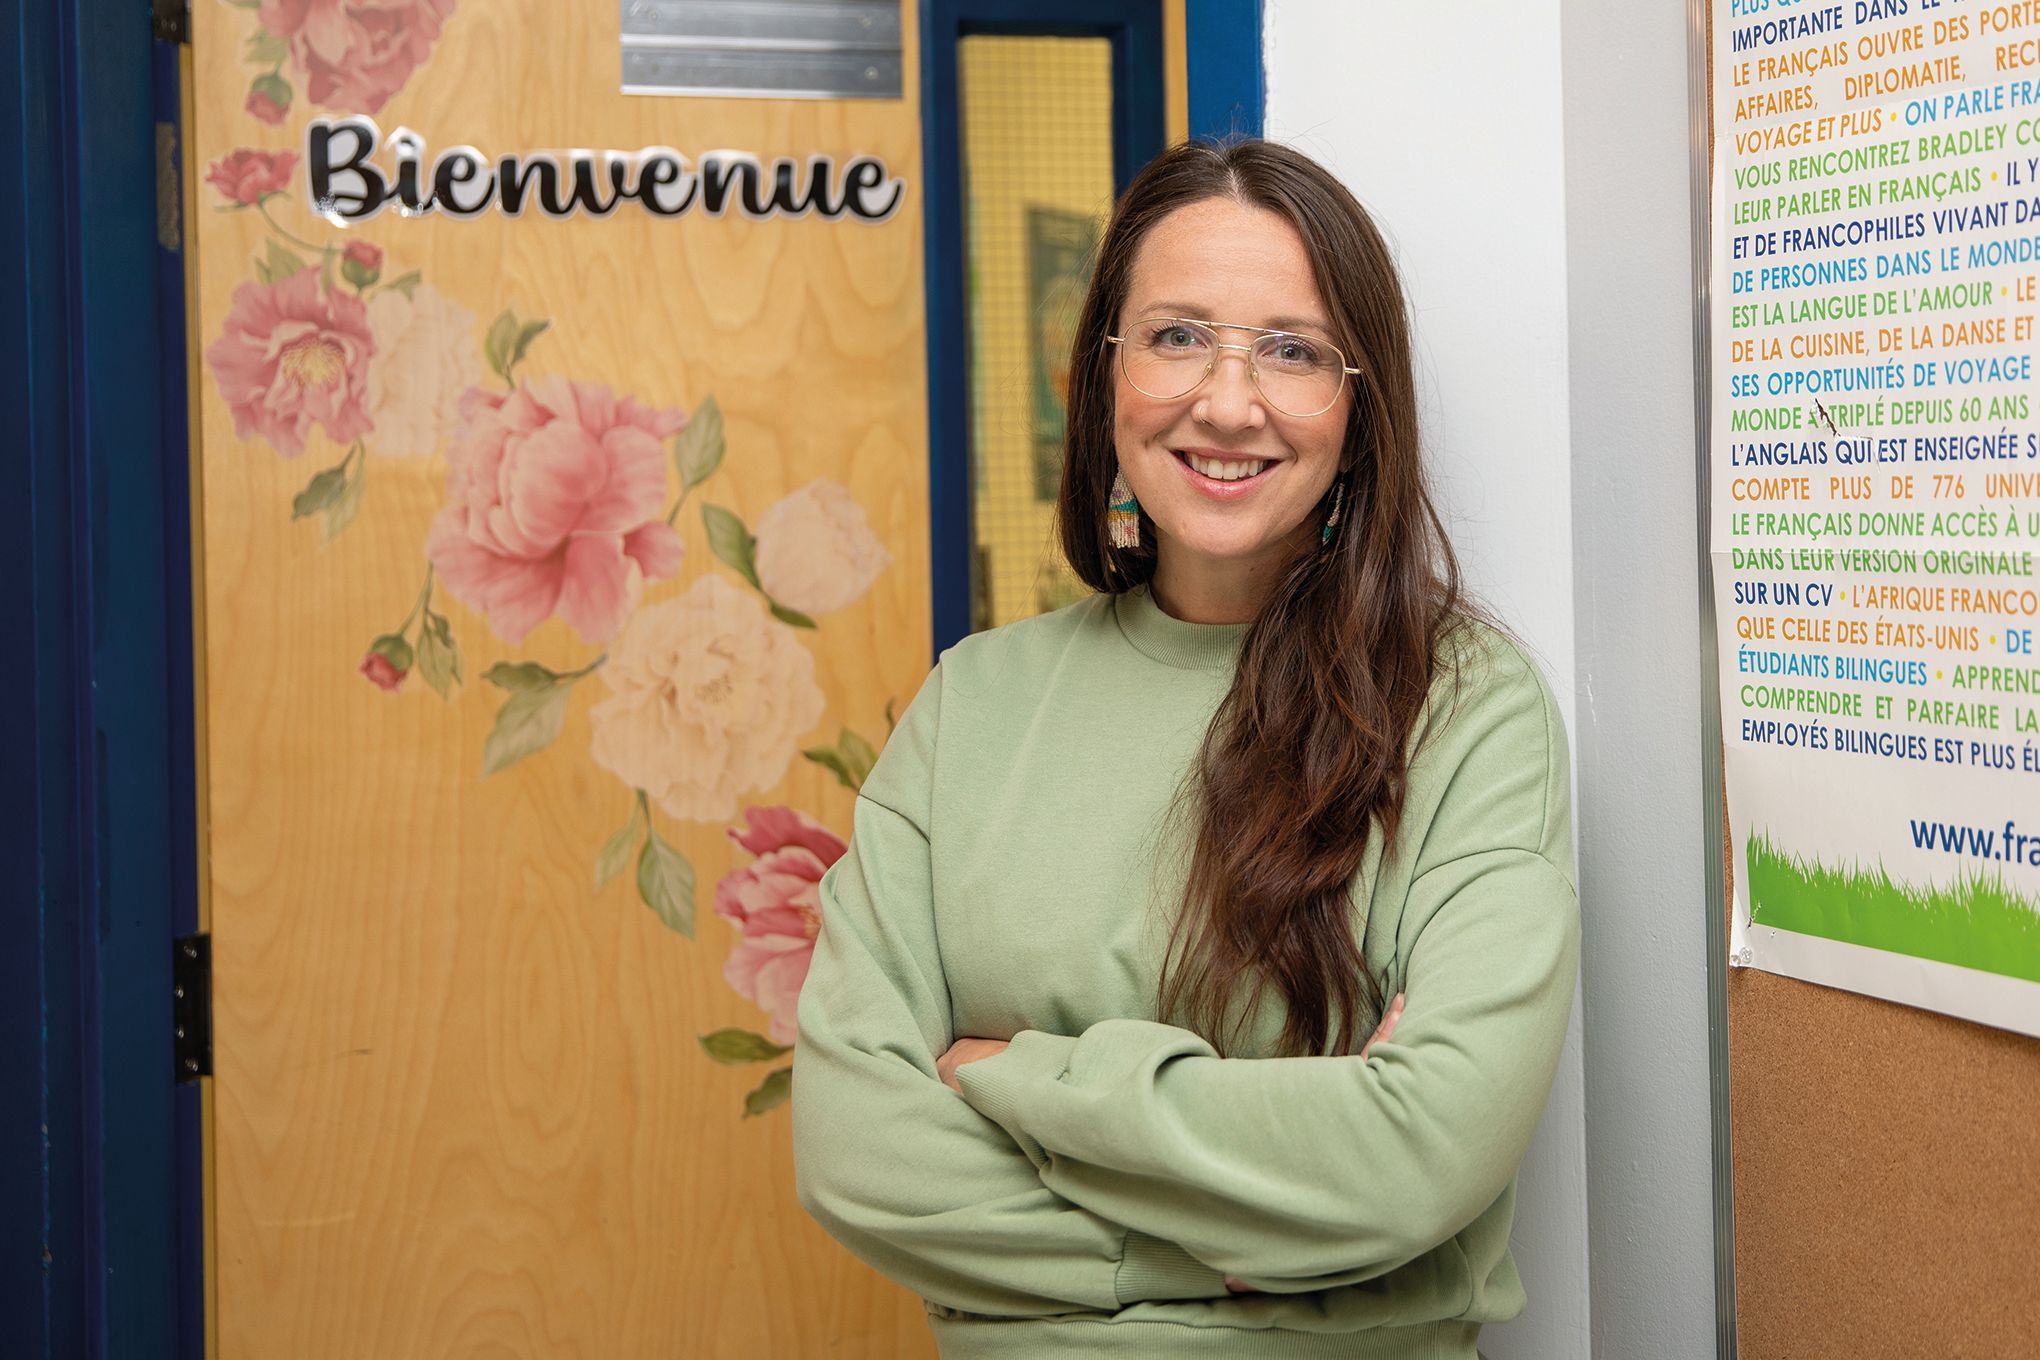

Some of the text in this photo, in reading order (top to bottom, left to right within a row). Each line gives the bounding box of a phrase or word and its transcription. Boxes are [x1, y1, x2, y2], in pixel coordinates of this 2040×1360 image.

[1733, 0, 1908, 52] IMPORTANTE DANS
[1734, 0, 2040, 87] LE FRANÇAIS OUVRE DES PORTE
[1735, 39, 2040, 123] AFFAIRES, DIPLOMATIE, REC
[1736, 121, 1812, 156] VOYAGE
[1817, 116, 1836, 142] ET
[1840, 108, 1882, 137] PLUS
[1905, 98, 1936, 126] ON
[1944, 85, 2003, 119] PARLE
[307, 120, 901, 218] Bienvenue
[1735, 161, 1781, 190] VOUS
[1789, 140, 1910, 181] RENCONTREZ
[1919, 124, 2007, 161] BRADLEY
[1735, 157, 2038, 225] LEUR PARLER EN FRANÇAIS IL Y
[1734, 236, 1749, 259] ET
[1755, 232, 1776, 256] DE
[1783, 213, 1925, 253] FRANCOPHILES
[1933, 201, 2008, 234] VIVANT
[1733, 236, 2040, 294] DE PERSONNES DANS LE MONDE
[1733, 276, 2035, 328] EST LA LANGUE DE L'AMOUR LE
[1732, 316, 2033, 363] DE LA CUISINE, DE LA DANSE ET
[1731, 355, 2030, 398] SES OPPORTUNITÉS DE VOYAGE
[1732, 407, 1802, 432] MONDE
[1829, 395, 1884, 428] TRIPLÉ
[1892, 399, 1952, 425] DEPUIS
[1960, 397, 1981, 422] 60
[1988, 395, 2028, 420] ANS
[1732, 427, 2040, 466] L'ANGLAIS QUI EST ENSEIGNÉE S
[1732, 473, 2040, 501] COMPTE PLUS DE 776 UNIV
[1733, 513, 1749, 535] LE
[1757, 512, 1852, 541] FRANÇAIS
[1859, 512, 1924, 536] DONNE
[1931, 505, 1997, 537] ACCÈS
[2006, 505, 2021, 536] À
[1732, 548, 2032, 576] DANS LEUR VERSION ORIGINALE
[1735, 581, 2038, 616] SUR UN CV L'AFRIQUE FRANCO
[1737, 616, 2032, 654] QUE CELLE DES ÉTATS-UNIS DE
[1739, 643, 2040, 694] ÉTUDIANTS BILINGUES APPREND
[1741, 685, 1862, 717] COMPRENDRE
[1876, 696, 1893, 720] ET
[1908, 699, 1999, 729] PARFAIRE
[1743, 719, 1828, 750] EMPLOYÉS
[1835, 728, 1927, 760] BILINGUES
[1935, 738, 1963, 764] EST
[1971, 742, 2015, 770] PLUS
